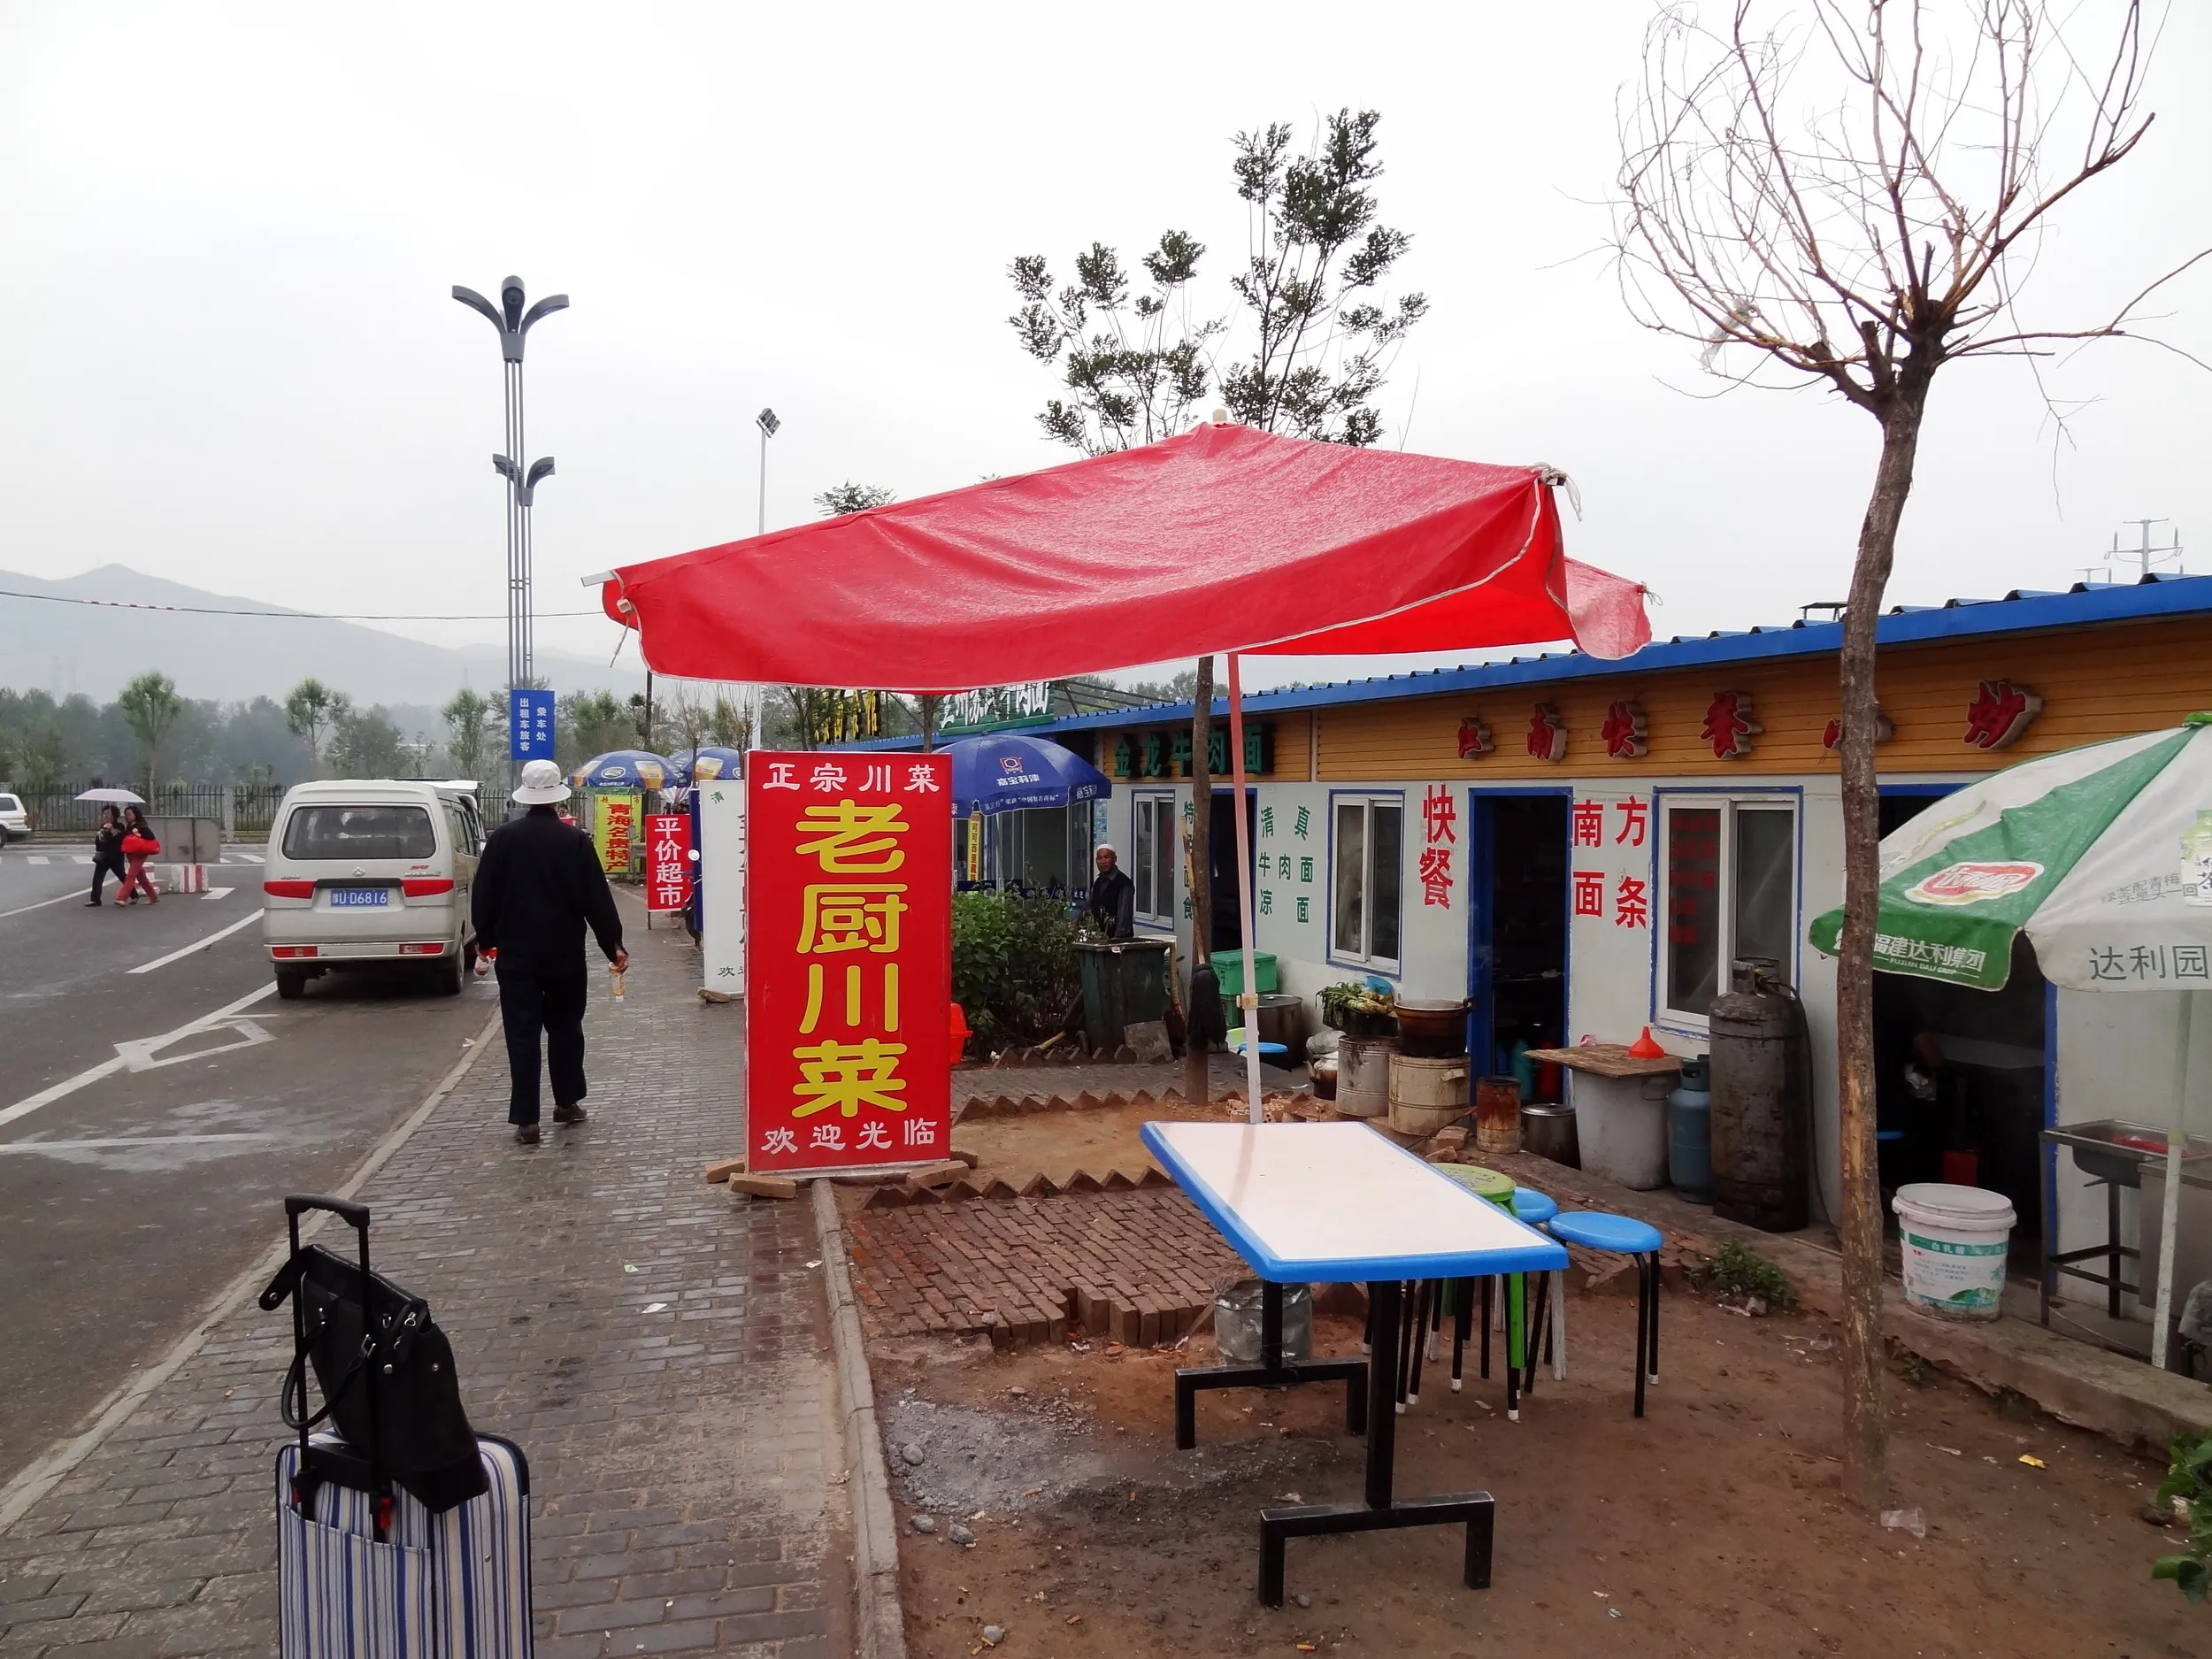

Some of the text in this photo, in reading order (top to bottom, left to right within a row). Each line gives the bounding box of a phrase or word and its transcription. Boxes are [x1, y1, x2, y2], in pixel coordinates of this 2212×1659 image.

[519, 697, 531, 751] 出租车旅客
[536, 707, 547, 741] 乘车处
[1113, 723, 1263, 777] 金龙牛肉面
[762, 763, 941, 794] 正宗川菜
[604, 803, 634, 872] 青海名贵特产
[1260, 805, 1310, 841] 清真
[1573, 795, 1648, 848] 南方
[654, 818, 683, 906] 平价超市
[1258, 851, 1313, 883] 牛肉面
[1419, 784, 1456, 910] 快餐
[1259, 888, 1310, 924] 凉面
[1573, 871, 1647, 929] 面条
[792, 798, 910, 1118] 老厨川菜
[1873, 933, 1987, 972] 福建达利集团
[2089, 944, 2209, 980] 达利园
[761, 1118, 937, 1156] 欢迎光临
